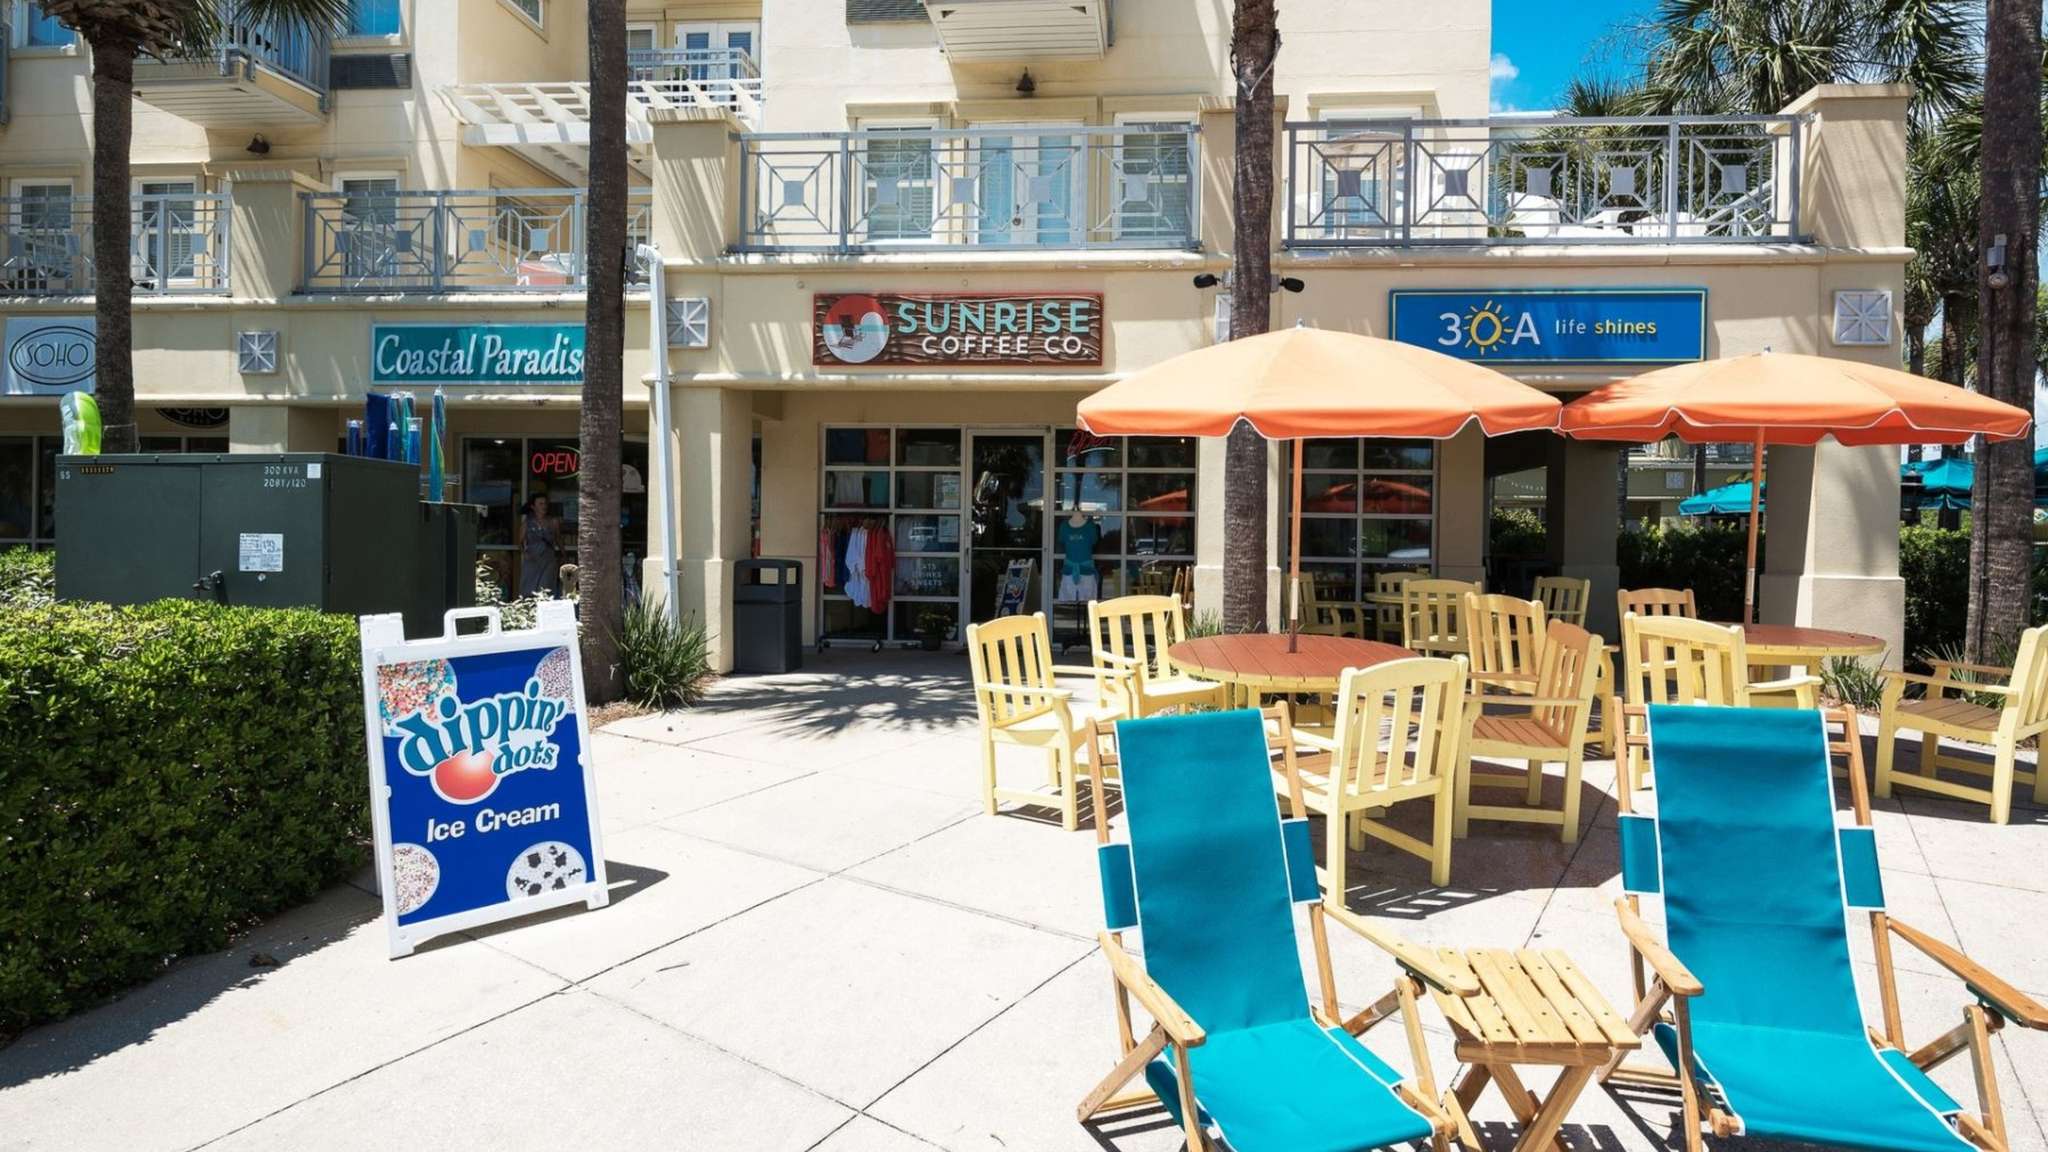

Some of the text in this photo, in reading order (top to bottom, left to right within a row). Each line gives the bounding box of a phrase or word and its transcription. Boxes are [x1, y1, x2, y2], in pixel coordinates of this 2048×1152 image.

[898, 301, 1090, 333] SUNRISE
[1555, 318, 1587, 335] life
[1594, 318, 1657, 335] shines
[26, 342, 89, 367] SOHO
[376, 333, 585, 376] Coastal Paradis
[921, 335, 1090, 355] COFFEE CO.
[531, 452, 578, 474] OPEN
[493, 740, 555, 775] dots
[426, 802, 560, 843] Ice Cream
